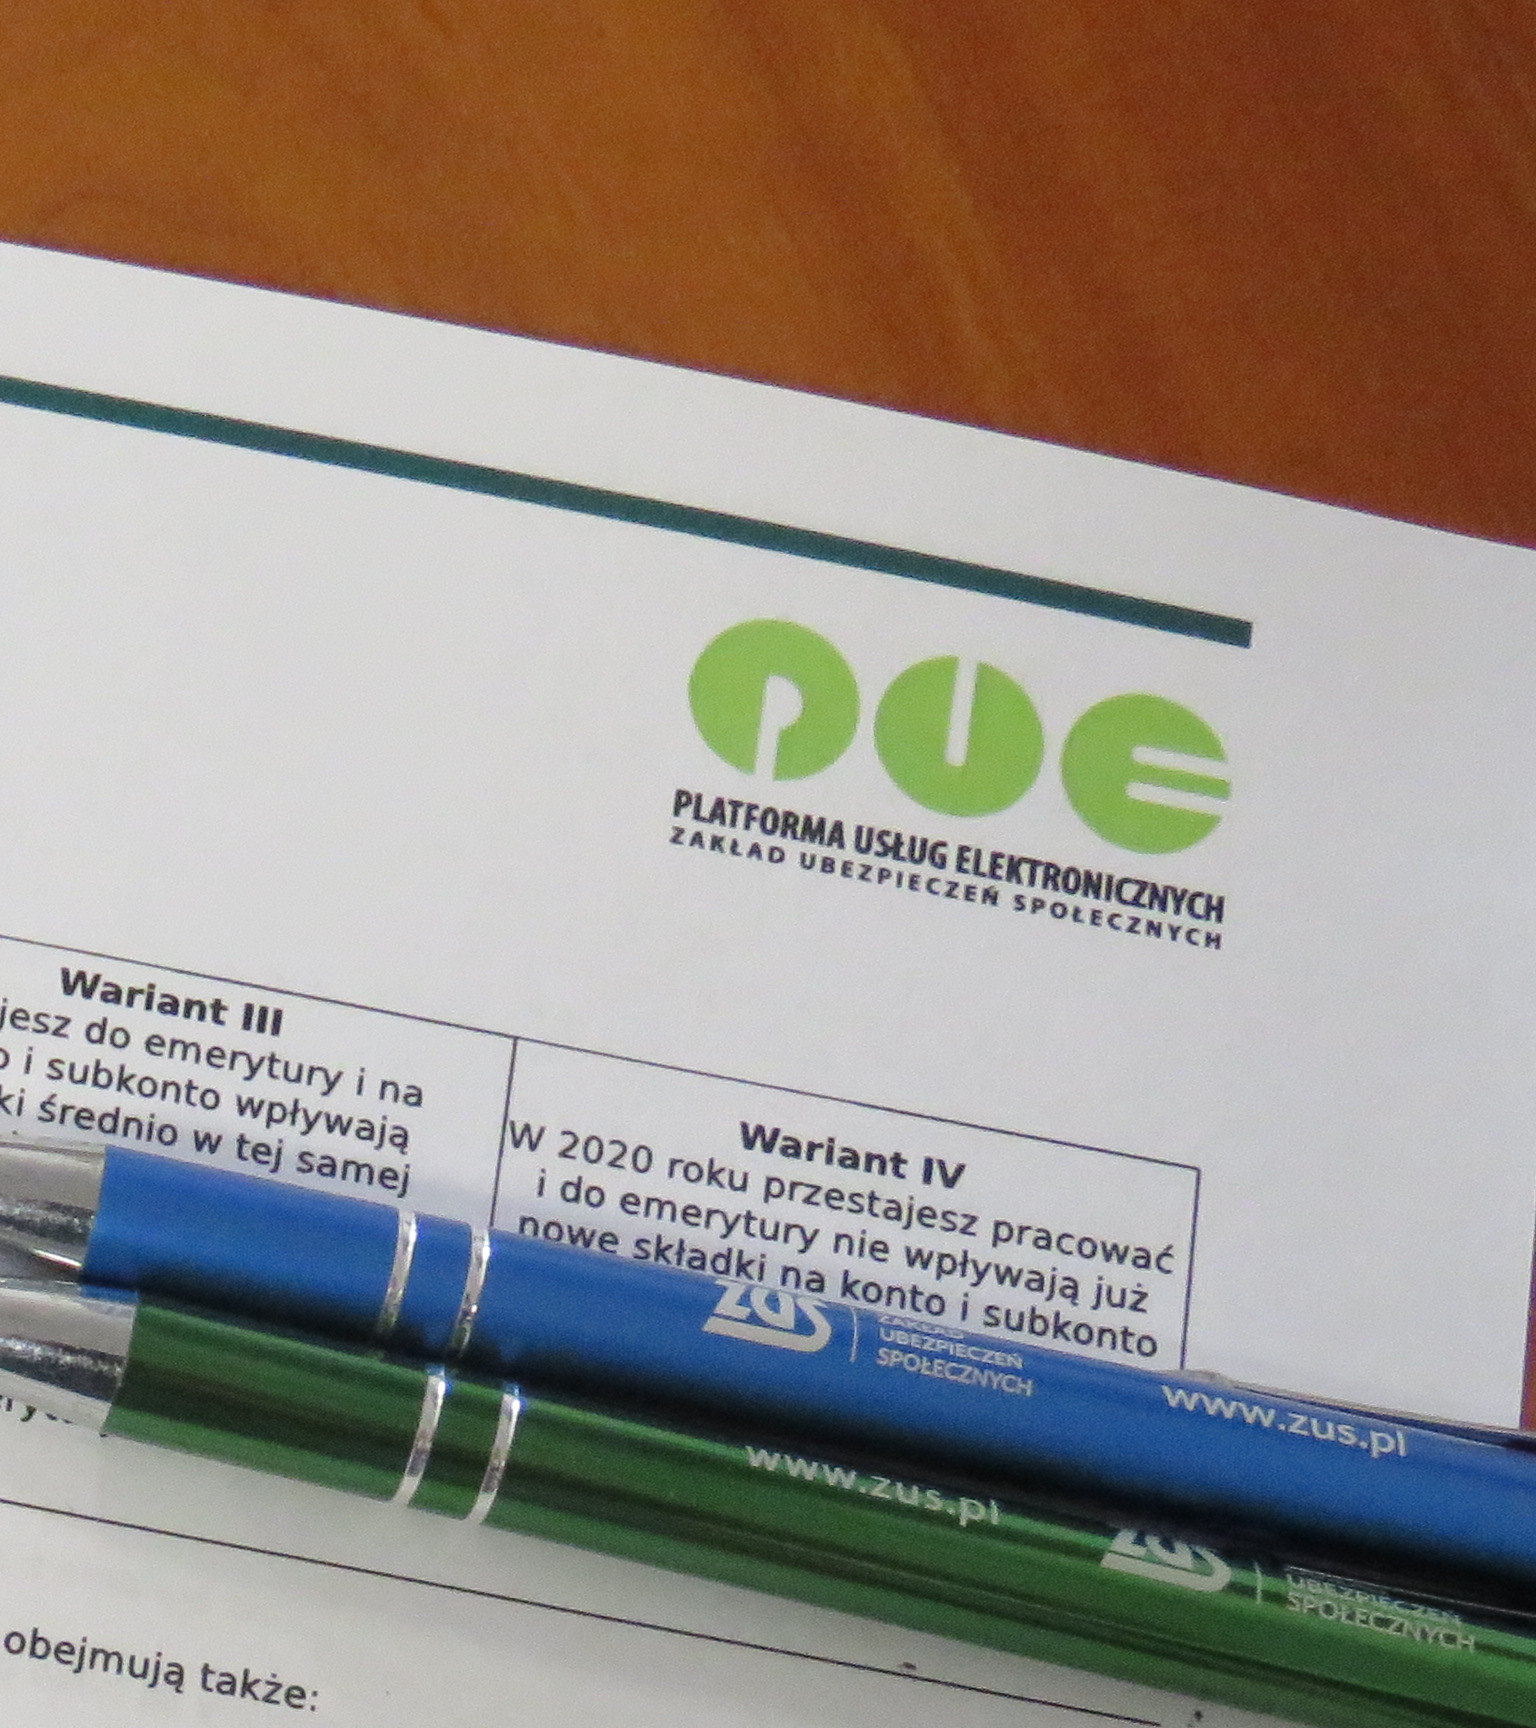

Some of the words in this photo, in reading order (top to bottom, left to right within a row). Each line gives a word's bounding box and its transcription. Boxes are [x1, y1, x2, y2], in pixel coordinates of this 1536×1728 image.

[670, 826, 786, 865] ZAKŁAD
[799, 850, 1000, 907] UBEZPIECZEŃ
[1013, 893, 1224, 950] SPOŁECZNYCH
[672, 789, 846, 850] PLATFORMA
[854, 824, 949, 871] USŁUG
[956, 843, 1225, 924] ELEKTRONICZNYCH
[61, 968, 228, 1026] Wariant
[242, 1003, 283, 1036] III
[741, 1122, 908, 1179] Wariant
[923, 1157, 966, 1189] IV
[510, 1121, 545, 1152] W
[558, 1131, 652, 1173] 2020
[668, 1158, 748, 1192] roku
[763, 1177, 979, 1236] przestajesz
[992, 1220, 1173, 1274] pracować
[876, 1346, 1033, 1398] SPOŁECZNYCH
[1161, 1379, 1408, 1459] www.zus.pl
[746, 1445, 1001, 1527] www.zus.pl
[4, 1628, 184, 1693] obejmują
[201, 1663, 317, 1711] także:
